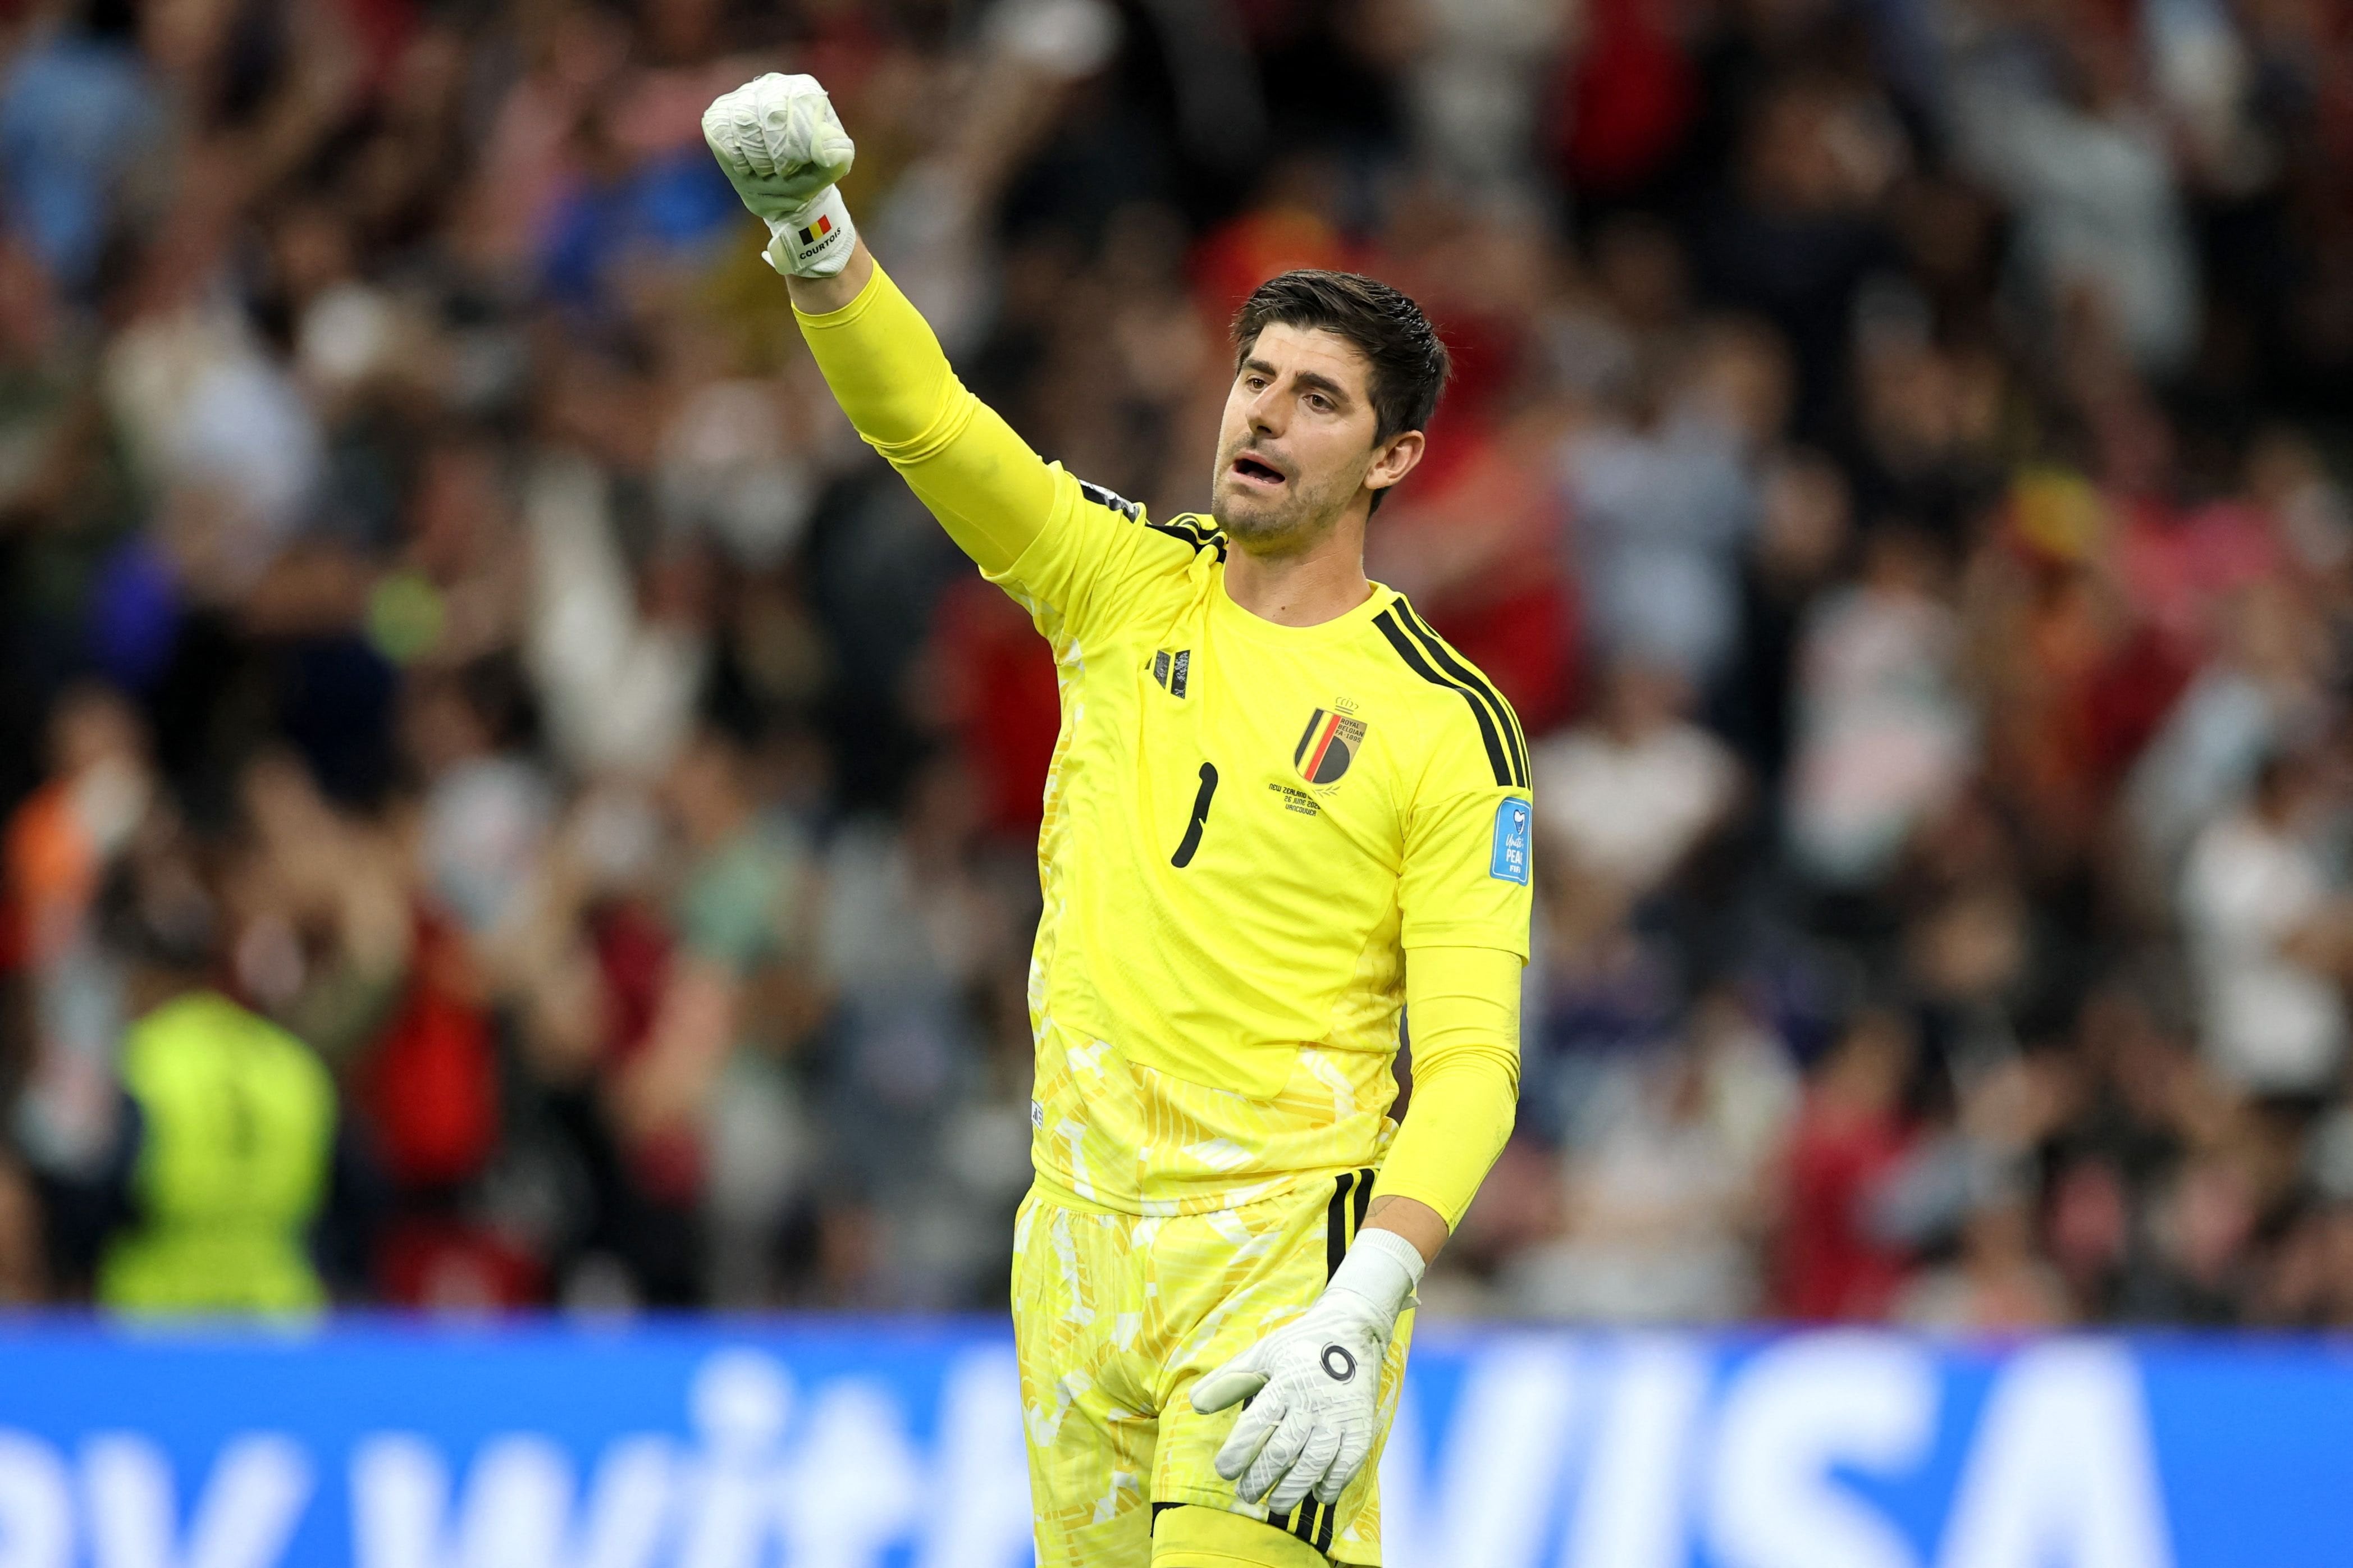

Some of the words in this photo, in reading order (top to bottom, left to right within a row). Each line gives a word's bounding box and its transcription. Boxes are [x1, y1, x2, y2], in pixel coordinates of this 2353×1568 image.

[799, 227, 841, 260] COURTOIS
[1338, 724, 1364, 737] BELGIAN
[1340, 718, 1359, 729] ROYAL
[1268, 783, 1281, 792] NEW
[1283, 787, 1307, 798] ZEALAND
[1171, 761, 1218, 868] 1
[1285, 803, 1317, 816] VANCOUVER
